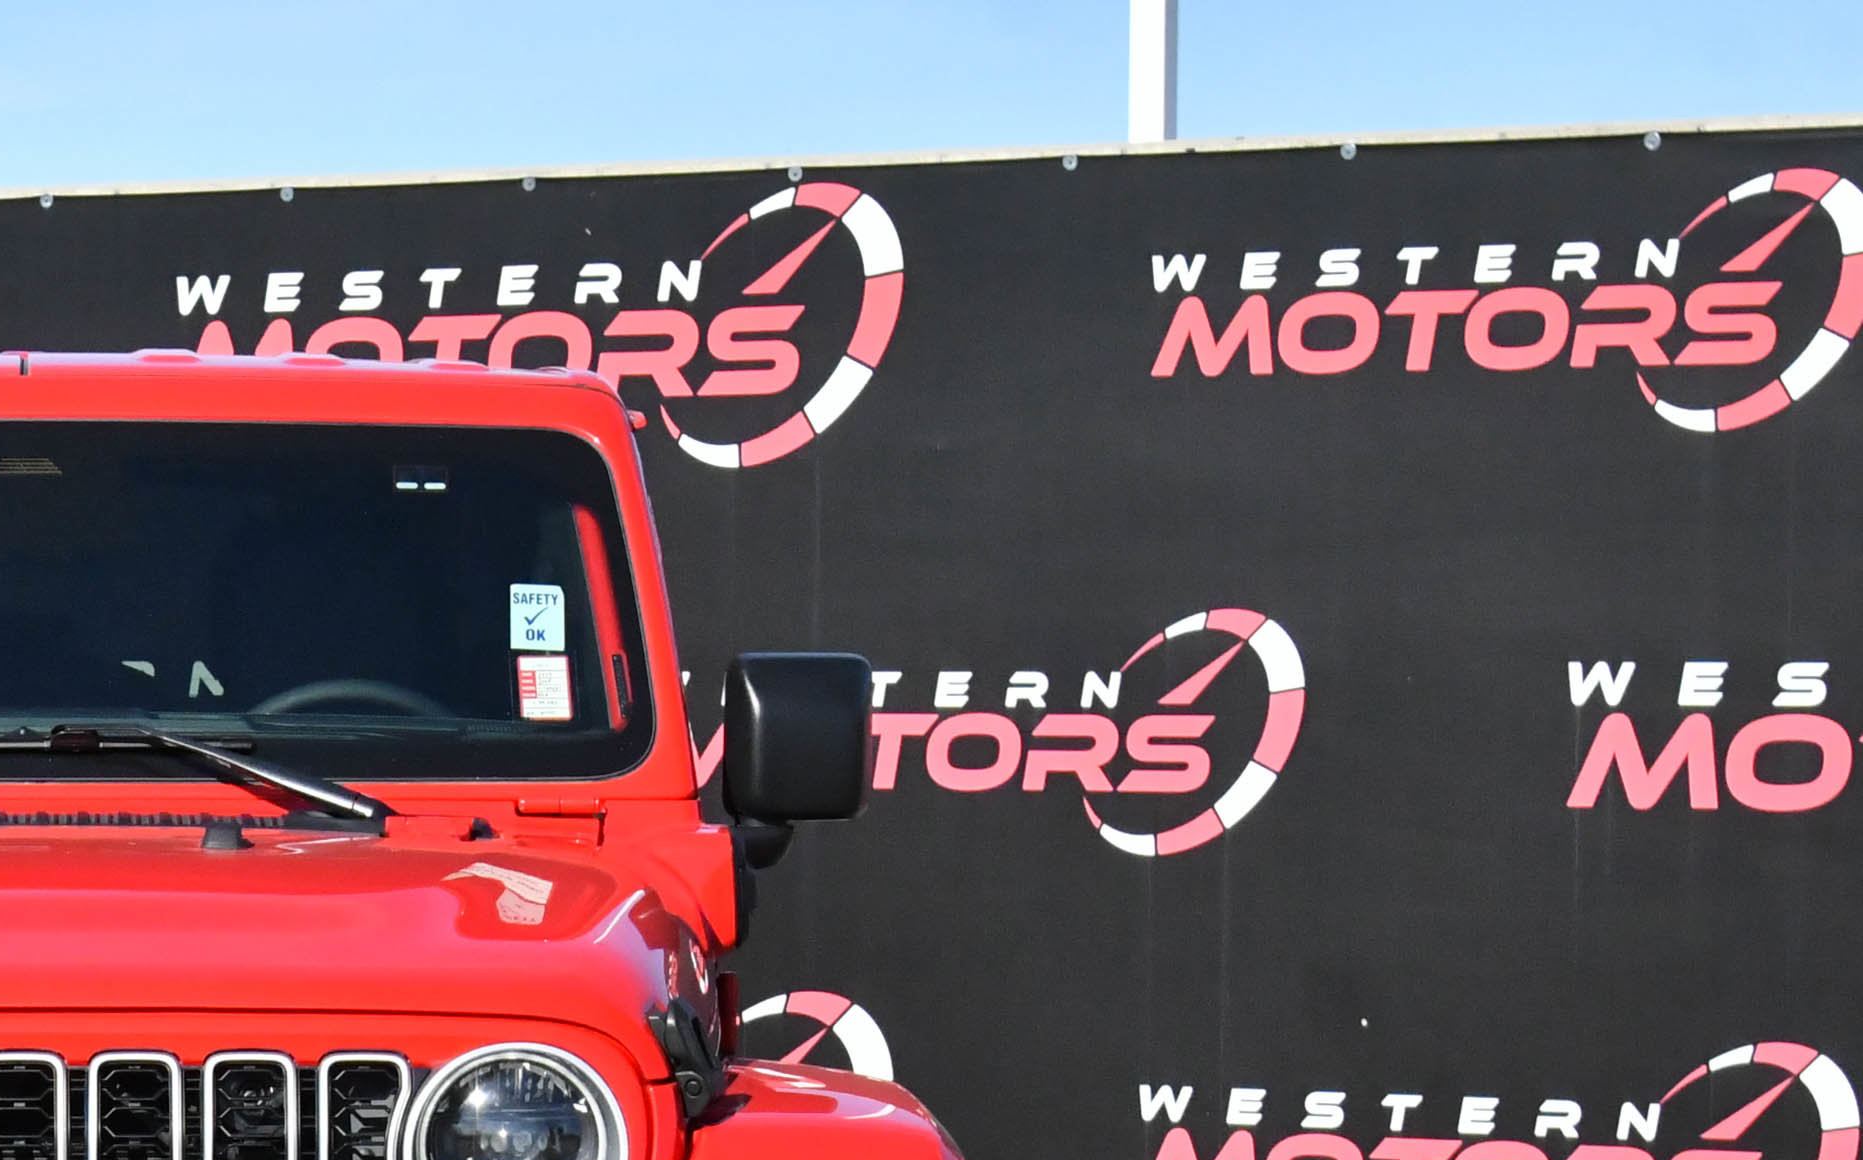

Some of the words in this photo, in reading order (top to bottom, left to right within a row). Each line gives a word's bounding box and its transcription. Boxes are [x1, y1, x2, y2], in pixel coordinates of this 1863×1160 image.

[176, 259, 701, 317] WESTERN
[1151, 237, 1680, 292] WESTERN
[1151, 280, 1783, 378] MOTORS
[512, 591, 559, 606] SAFETY
[525, 628, 547, 642] OK
[1567, 660, 1830, 708] WES
[1565, 711, 1863, 813] MO
[1138, 1084, 1662, 1142] WESTERN
